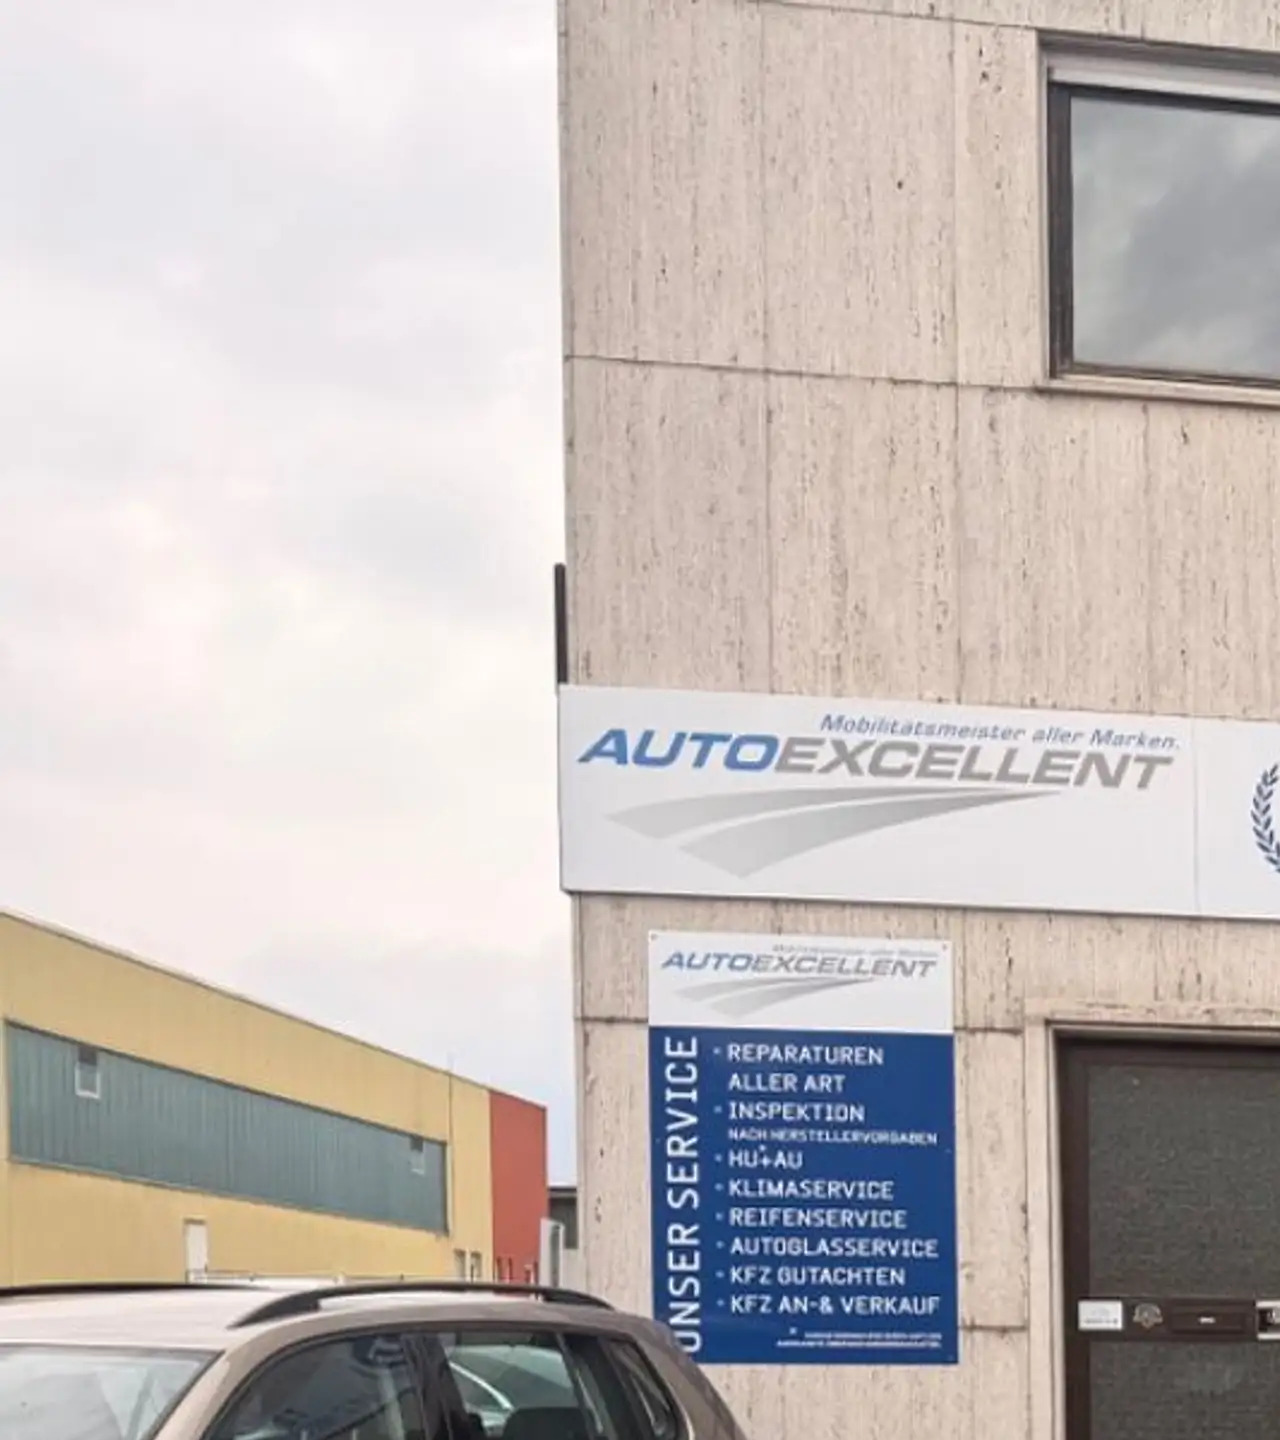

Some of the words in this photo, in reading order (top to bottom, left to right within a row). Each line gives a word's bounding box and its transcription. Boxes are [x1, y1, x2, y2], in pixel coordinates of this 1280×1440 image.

[1032, 726, 1084, 745] aller
[1090, 728, 1181, 750] Marken.
[577, 729, 1174, 789] AUTOEXCELLENT
[660, 951, 937, 978] AUTOEXCELLENT
[727, 1044, 884, 1066] REPARATUREN
[728, 1073, 798, 1093] ALLER
[803, 1074, 846, 1093] ART
[728, 1101, 866, 1122] INSPEKTION
[665, 1036, 700, 1210] SERVICE
[727, 1127, 767, 1142] NACH
[769, 1128, 938, 1145] HERSTELLERVORGABEN
[728, 1178, 895, 1201] KLIMASERVICE
[729, 1207, 908, 1229] REIFENSERVICE
[730, 1236, 940, 1259] AUTOGLASSERVICE
[668, 1222, 703, 1352] UNSER
[730, 1266, 772, 1286] KFZ
[776, 1266, 906, 1287] GUTACHTEN
[730, 1295, 773, 1315] KFZ
[840, 1296, 941, 1316] VERKAUF
